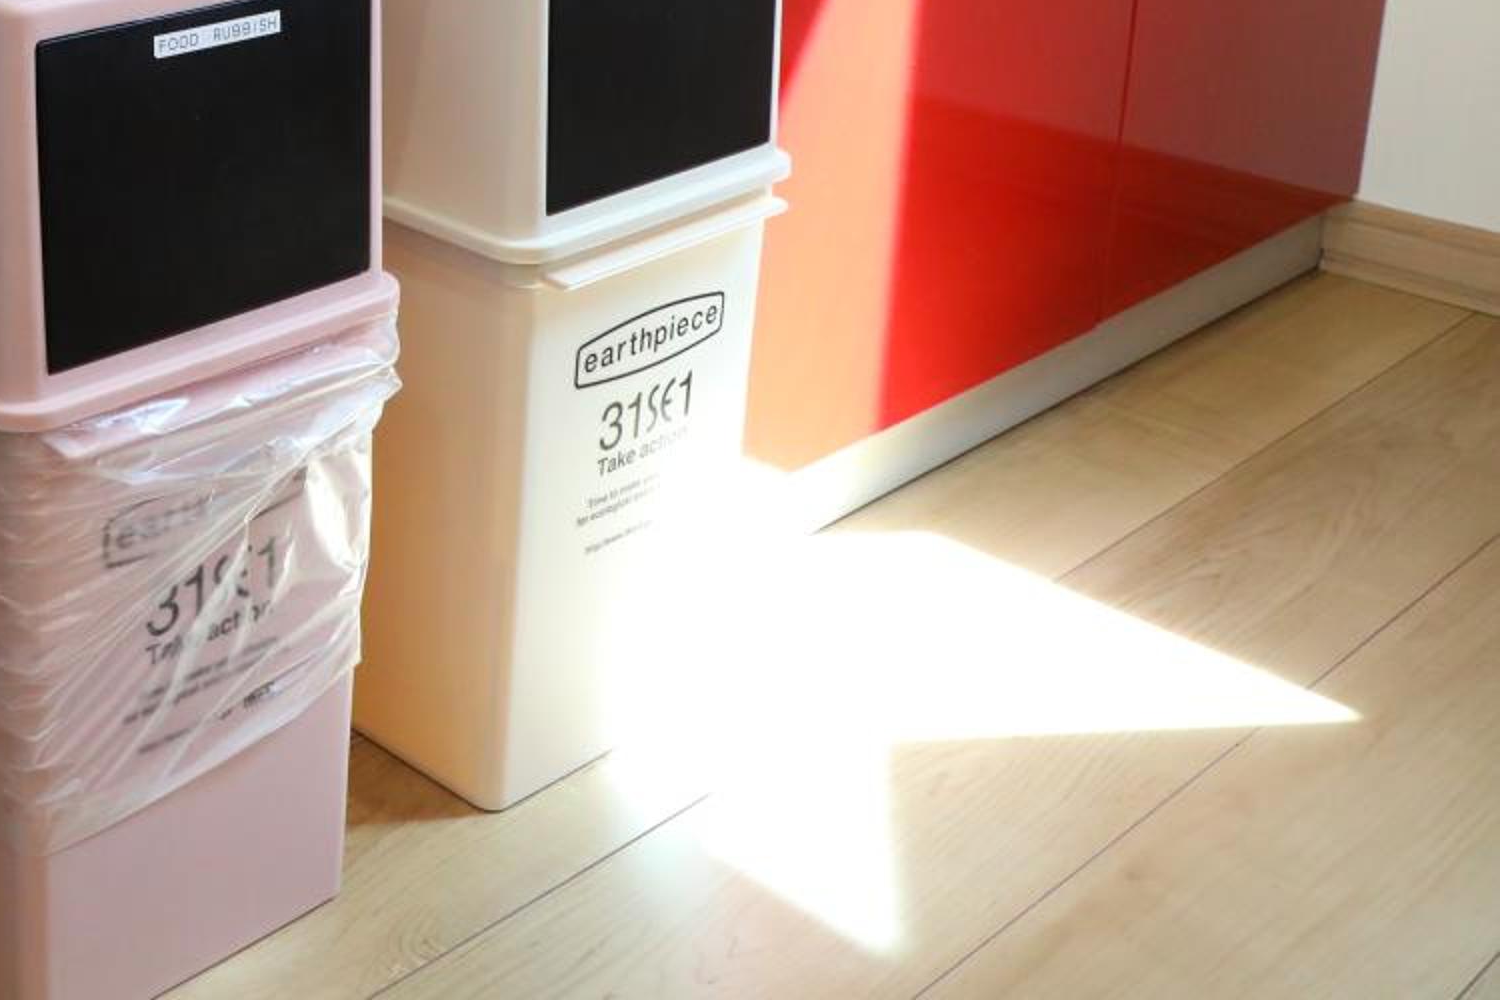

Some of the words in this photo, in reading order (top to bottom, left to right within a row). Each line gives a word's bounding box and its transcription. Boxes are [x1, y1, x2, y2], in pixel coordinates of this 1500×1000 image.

[158, 33, 199, 53] FOOD
[583, 304, 718, 374] earthpiece
[597, 449, 636, 476] Take
